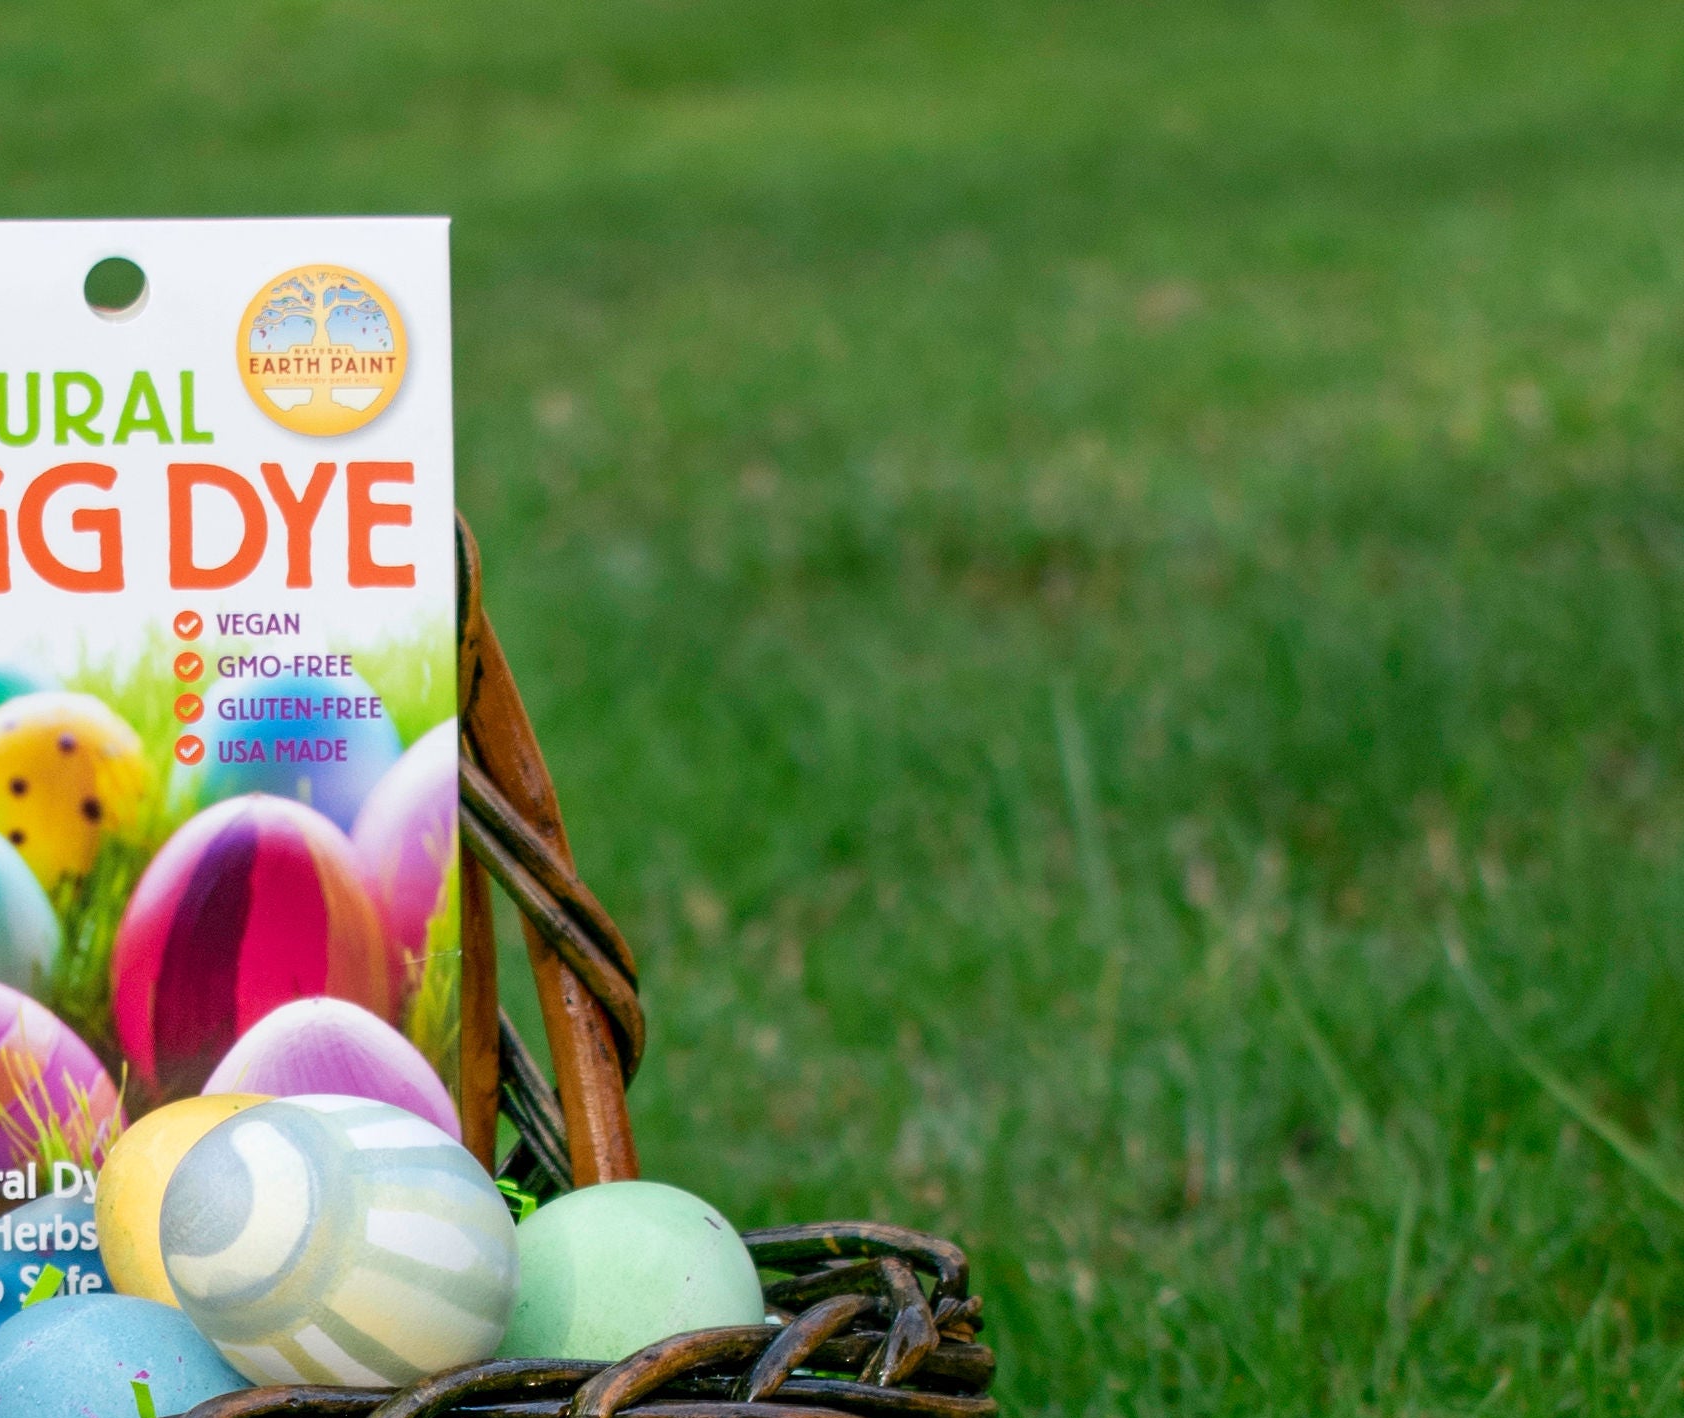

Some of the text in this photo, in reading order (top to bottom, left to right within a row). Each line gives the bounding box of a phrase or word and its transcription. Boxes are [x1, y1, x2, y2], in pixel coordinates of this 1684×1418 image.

[249, 357, 397, 374] EARTH PAINT
[167, 461, 416, 589] DYE
[216, 613, 300, 636] VEGAN
[217, 655, 353, 678] GMO-FREE
[218, 696, 382, 721] GLUTEN-FREE
[218, 739, 347, 763] USA MADE
[20, 1264, 103, 1303] Sfe
